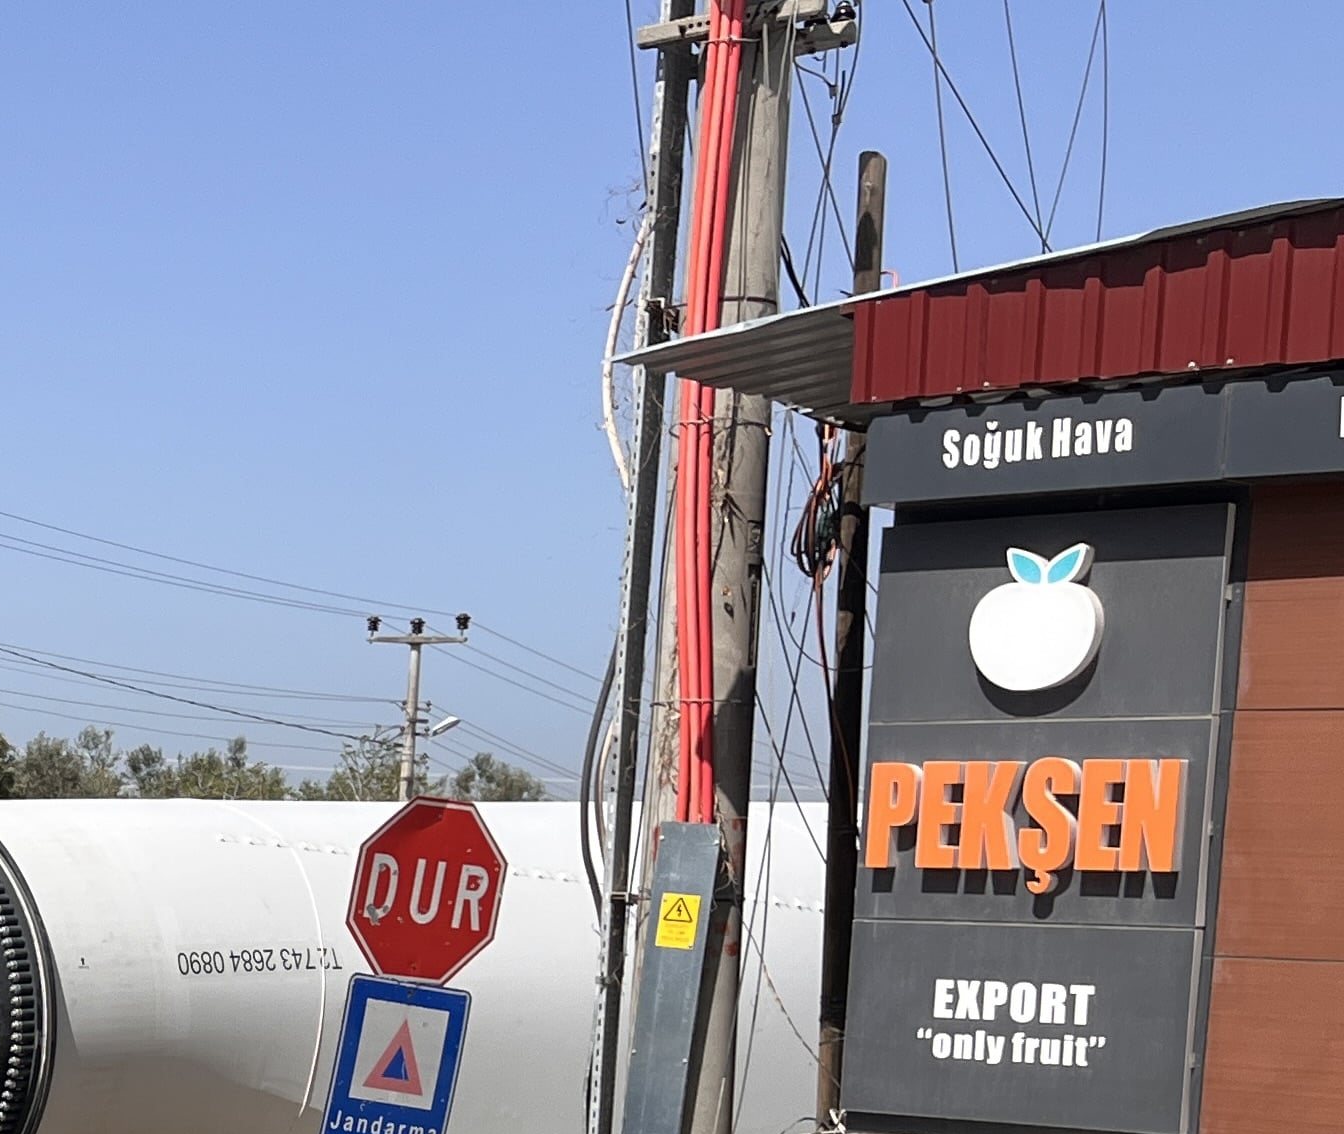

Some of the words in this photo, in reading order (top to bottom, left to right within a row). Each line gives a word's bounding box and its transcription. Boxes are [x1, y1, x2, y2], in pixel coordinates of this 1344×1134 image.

[942, 420, 1043, 470] Soğuk
[1051, 417, 1133, 458] Hava
[865, 757, 1183, 895] PEKŞEN
[363, 853, 490, 932] DUR
[177, 951, 224, 976] 0890
[229, 949, 276, 973] 2684
[933, 978, 1096, 1026] EXPORT
